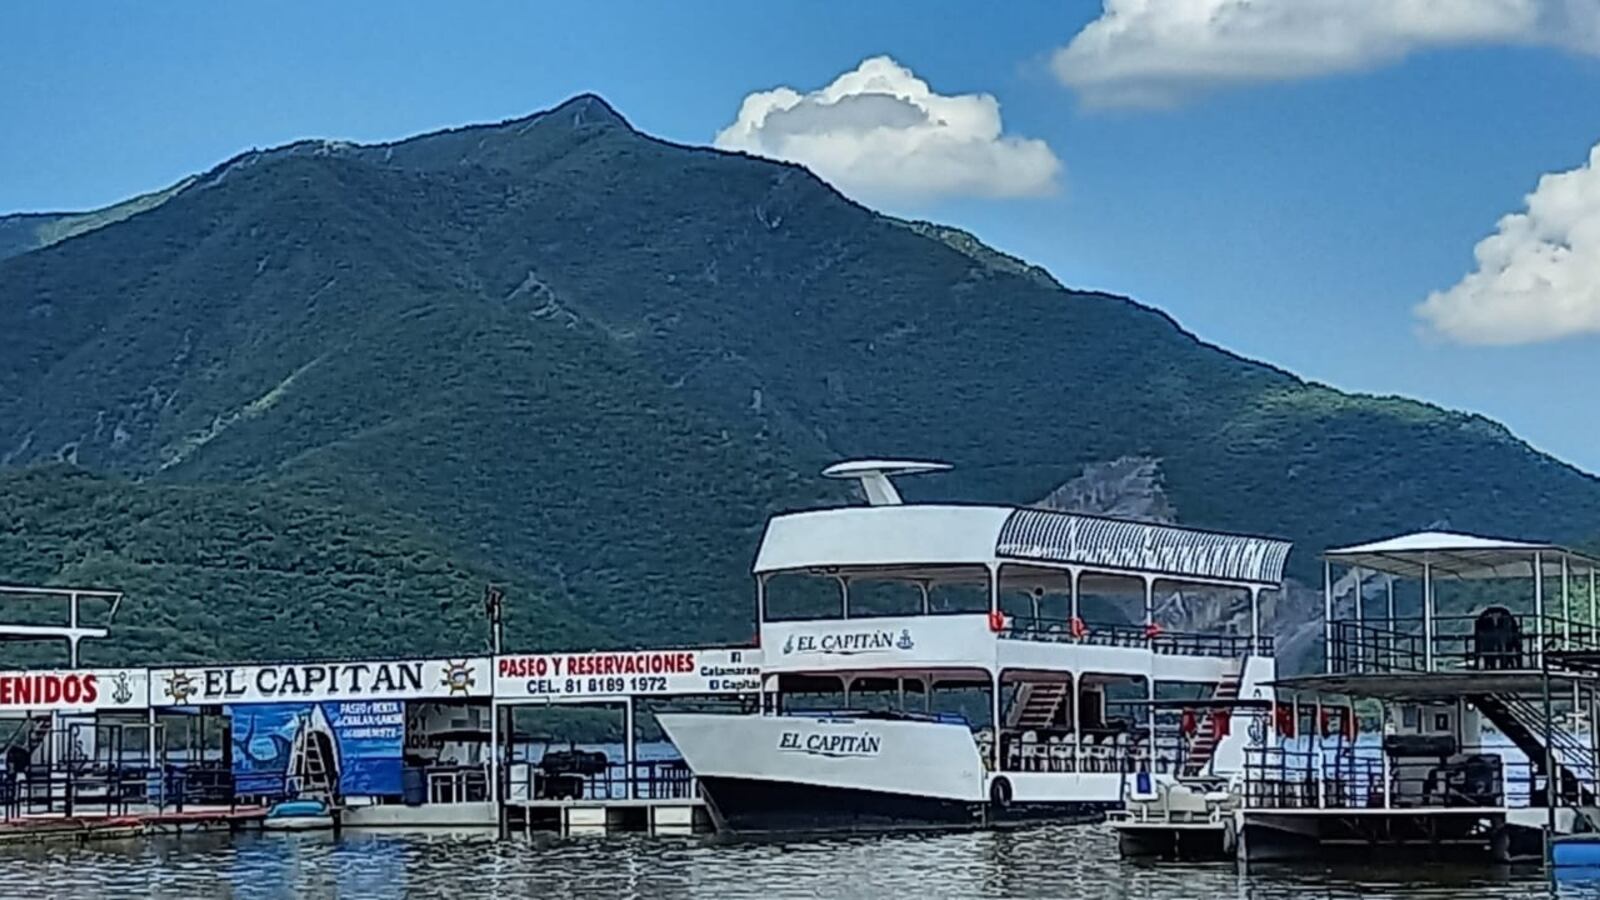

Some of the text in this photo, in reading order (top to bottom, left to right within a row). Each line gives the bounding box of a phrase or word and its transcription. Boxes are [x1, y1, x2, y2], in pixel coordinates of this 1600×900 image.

[797, 629, 894, 651] EL CAPITÁN
[499, 653, 695, 678] PASEO Y RESERVACIONES
[204, 669, 247, 697] EL
[527, 677, 667, 694] CEL. 81 8189 1972
[780, 731, 880, 752] EL CAPITÁN
